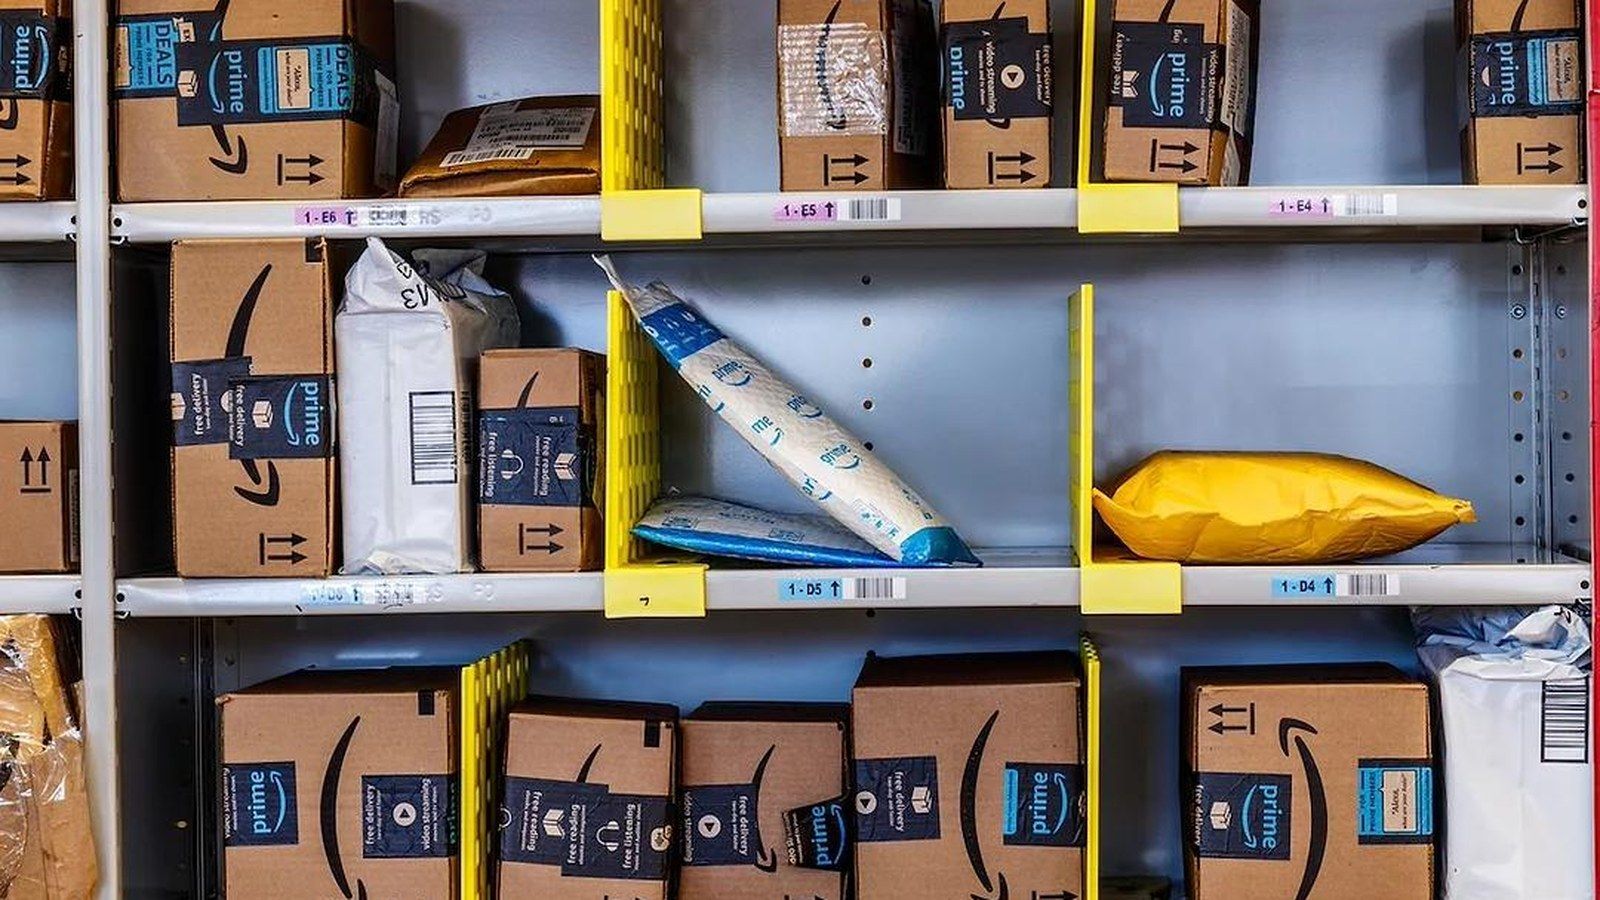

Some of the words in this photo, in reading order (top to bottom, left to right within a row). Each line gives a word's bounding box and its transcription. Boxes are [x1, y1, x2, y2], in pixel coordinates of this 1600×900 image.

[10, 25, 33, 88] prime
[156, 24, 173, 85] DEALS
[986, 41, 996, 66] video
[1112, 32, 1125, 72] delivery
[1209, 50, 1219, 75] video
[223, 50, 247, 113] prime
[336, 47, 350, 108] DEALS
[951, 46, 969, 110] prime
[986, 68, 997, 114] streaming
[1111, 75, 1121, 94] free
[1167, 53, 1190, 117] prime
[1495, 42, 1519, 104] prime
[304, 211, 311, 223] 1
[322, 211, 337, 223] E6
[784, 204, 790, 216] 1
[801, 204, 817, 217] E5
[1279, 200, 1285, 212] 1
[1297, 200, 1312, 212] E4
[712, 359, 743, 382] prime
[191, 373, 203, 413] delivery
[236, 385, 246, 404] free
[193, 415, 204, 435] free
[235, 405, 248, 447] delivery
[300, 382, 325, 446] prime
[489, 432, 498, 452] free
[541, 437, 552, 457] free
[820, 444, 851, 466] prime
[485, 454, 498, 498] listening
[539, 459, 550, 496] reading
[789, 584, 795, 595] 1
[806, 583, 822, 596] D5
[1281, 581, 1288, 592] 1
[1300, 580, 1315, 593] D4
[894, 771, 904, 791] free
[1195, 784, 1204, 804] free
[247, 771, 271, 833] prime
[365, 784, 376, 824] delivery
[420, 778, 432, 824] streaming
[532, 791, 543, 812] free
[684, 791, 693, 816] video
[739, 795, 749, 815] free
[895, 792, 906, 832] delivery
[1028, 772, 1051, 834] prime
[1260, 785, 1283, 848] prime
[365, 825, 375, 845] free
[420, 825, 431, 850] video
[527, 813, 538, 851] reading
[568, 804, 581, 842] reading
[623, 804, 636, 848] listening
[738, 817, 749, 856] delivery
[811, 806, 832, 866] prime
[1195, 806, 1204, 846] delivery
[567, 843, 577, 864] free
[622, 849, 632, 869] free
